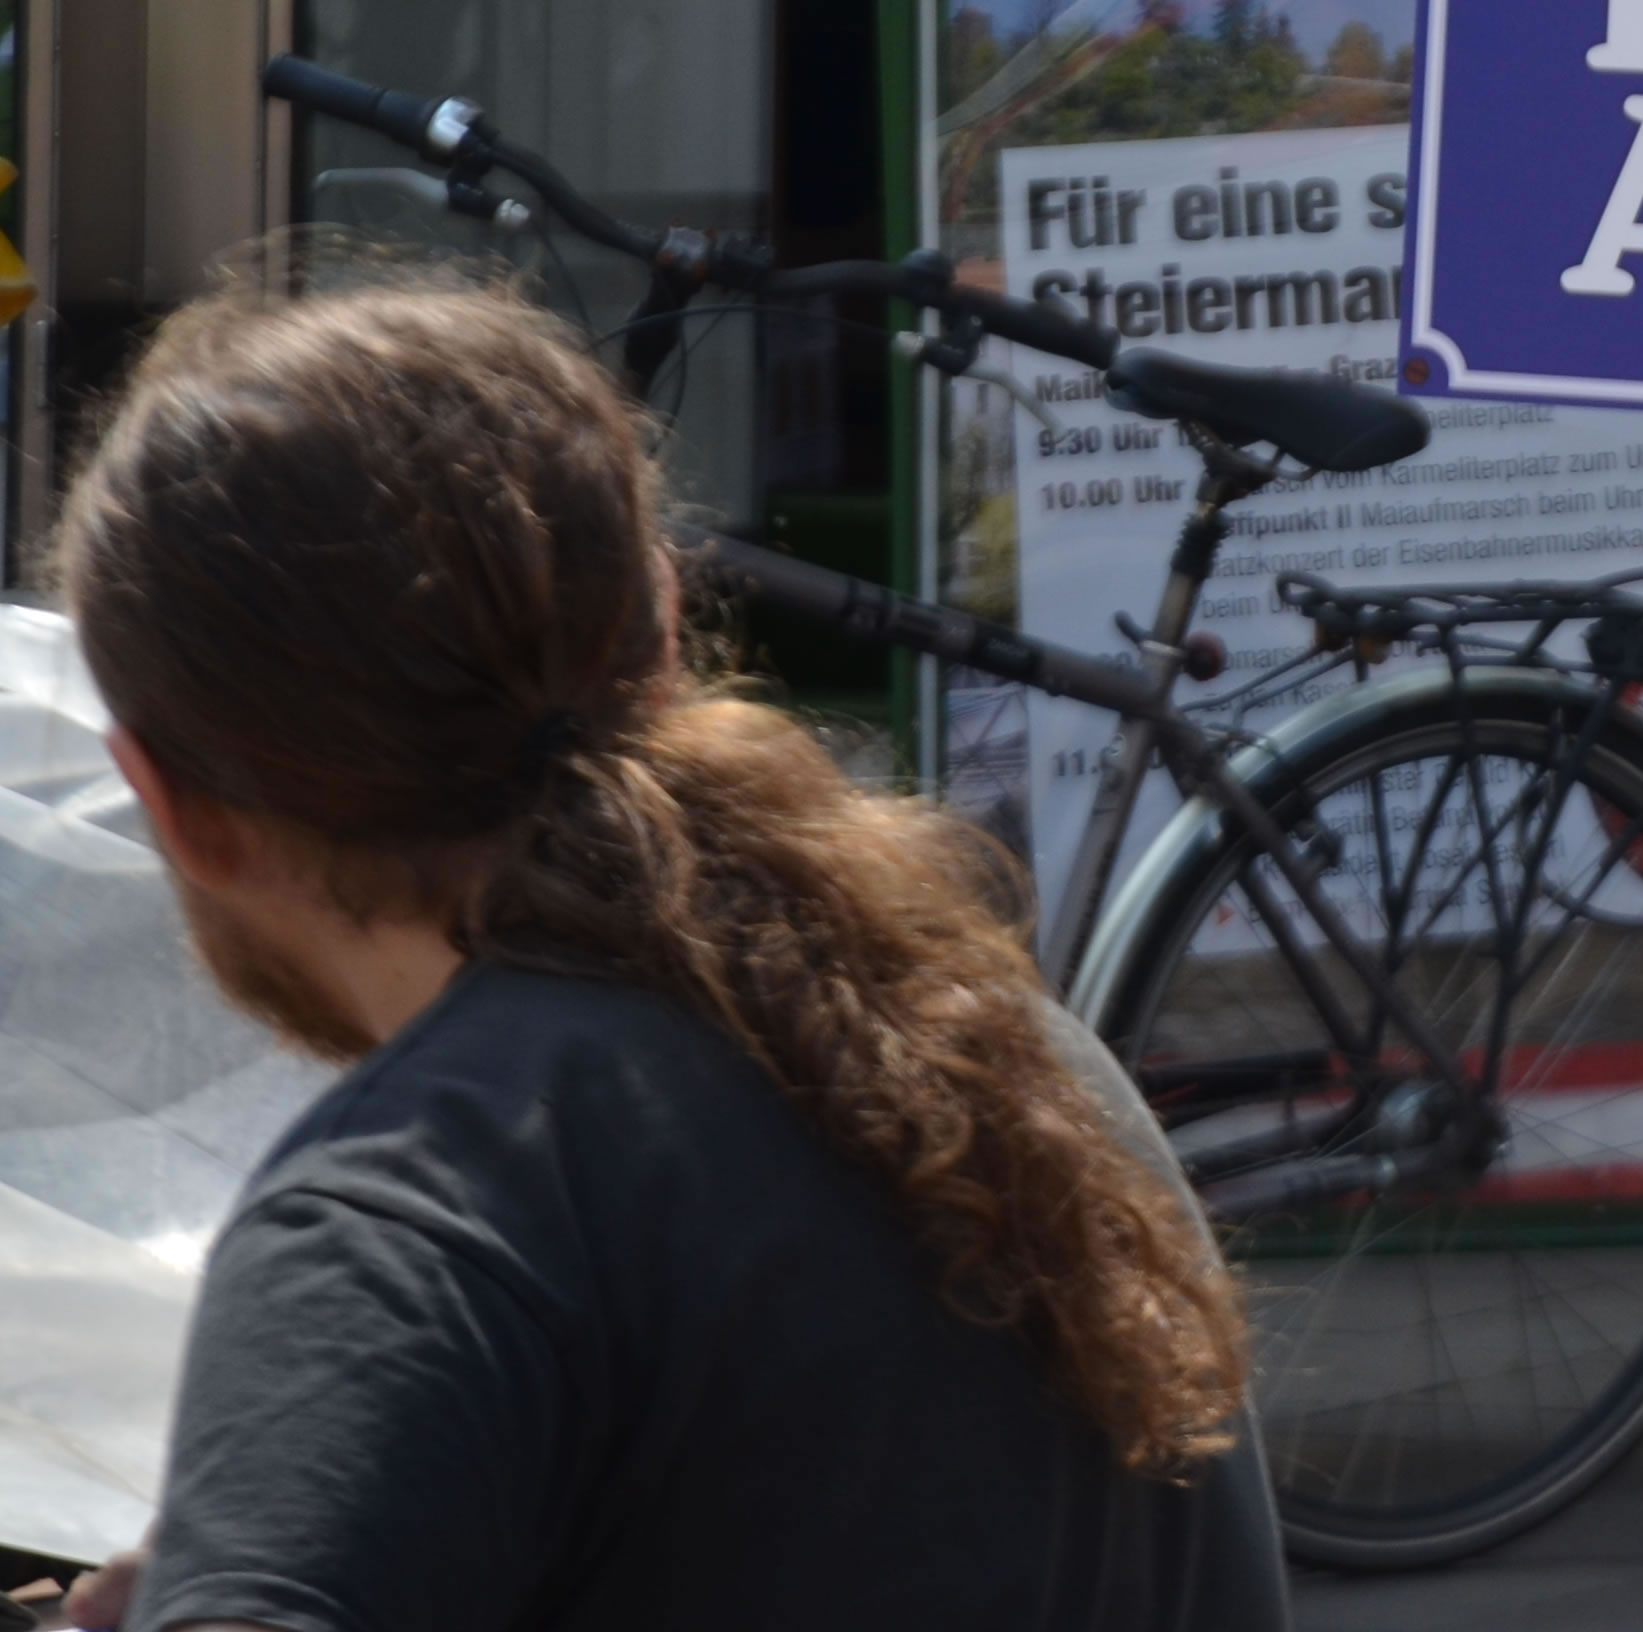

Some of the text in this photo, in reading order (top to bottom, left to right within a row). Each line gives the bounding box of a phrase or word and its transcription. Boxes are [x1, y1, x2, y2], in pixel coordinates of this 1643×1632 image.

[1028, 175, 1147, 251] Für
[1172, 167, 1341, 242] eine
[1111, 422, 1163, 452] Uhr
[1381, 450, 1561, 486] Karmeliterplatz
[1568, 451, 1617, 474] zum
[1041, 474, 1186, 510] 10.00 Uhr
[1361, 492, 1531, 529] Maiaufmarsch
[1538, 488, 1596, 516] beim
[1351, 543, 1389, 570] der
[1201, 592, 1259, 620] beim
